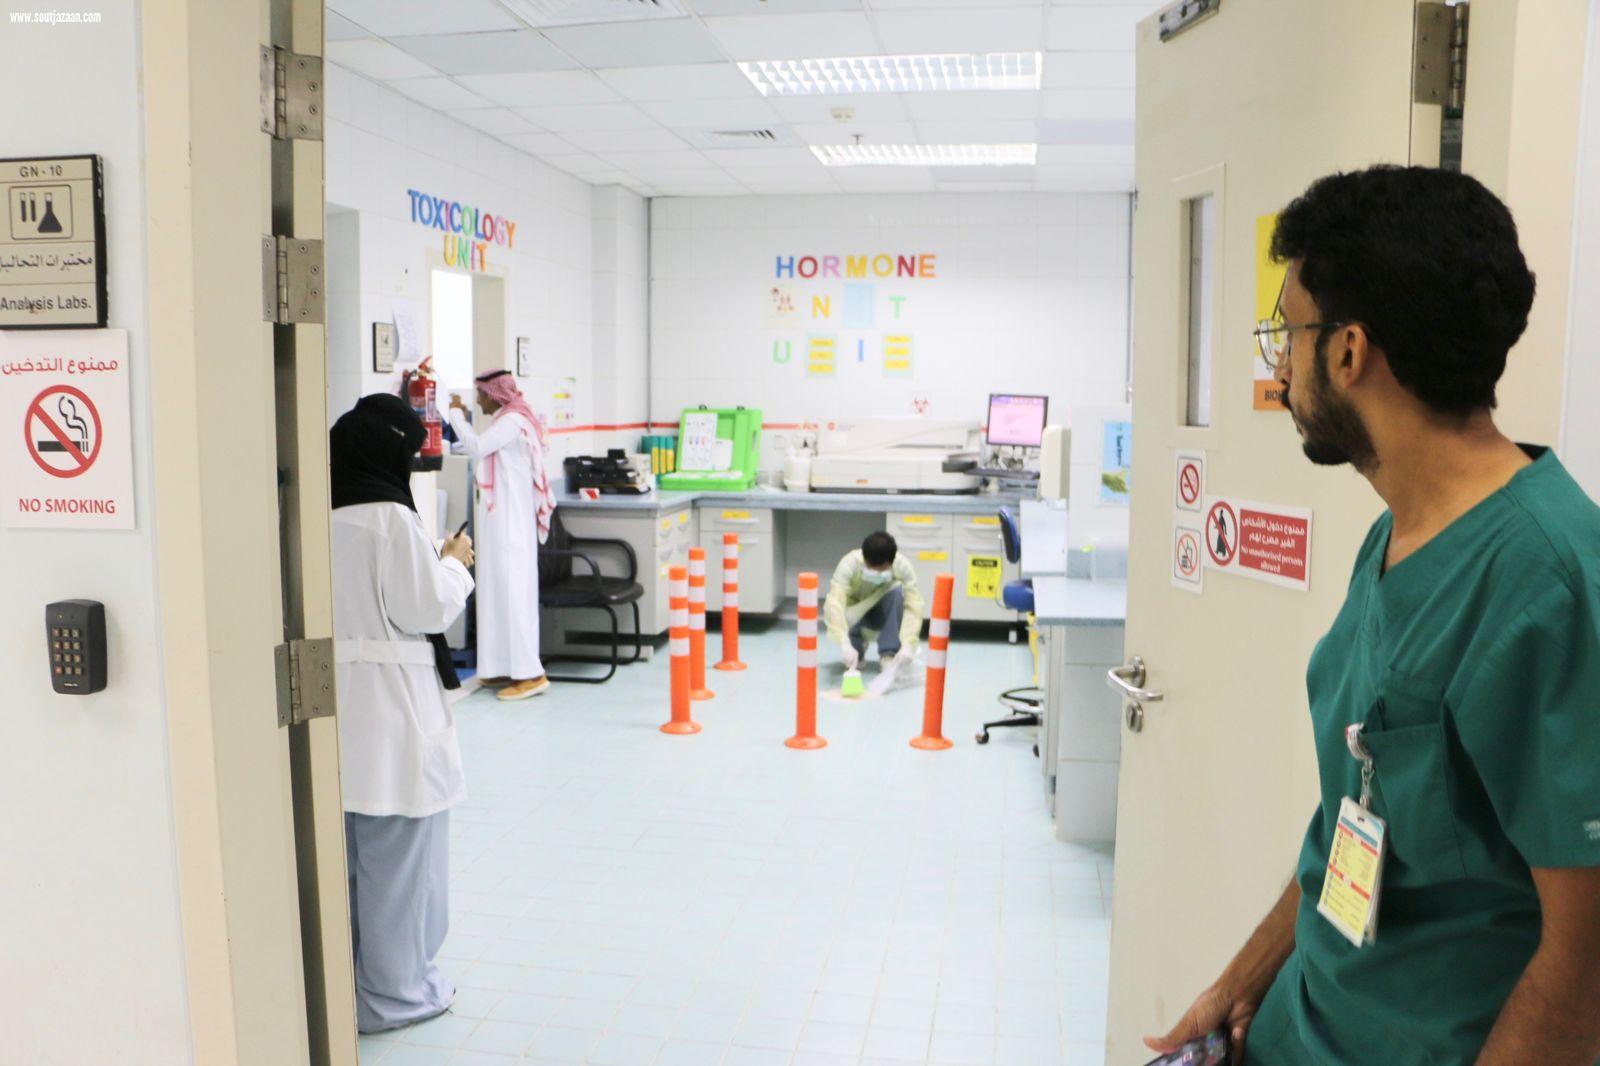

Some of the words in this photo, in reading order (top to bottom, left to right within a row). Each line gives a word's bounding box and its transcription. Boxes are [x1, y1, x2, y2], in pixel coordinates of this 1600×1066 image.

[20, 166, 39, 178] GN
[49, 165, 63, 177] 10
[407, 190, 515, 248] TOXICOLOGY
[45, 252, 93, 271] مختبرات
[443, 235, 487, 272] UNIT
[776, 254, 936, 279] HORMONE
[0, 295, 54, 314] Analysis
[57, 295, 92, 310] Labs.
[812, 295, 831, 318] N
[889, 296, 907, 319] T
[773, 340, 792, 364] U
[1, 357, 63, 375] التدخين
[67, 357, 118, 374] ممنوع
[19, 498, 41, 512] NO
[45, 498, 116, 514] SMOKING
[1283, 525, 1305, 536] ممنوع
